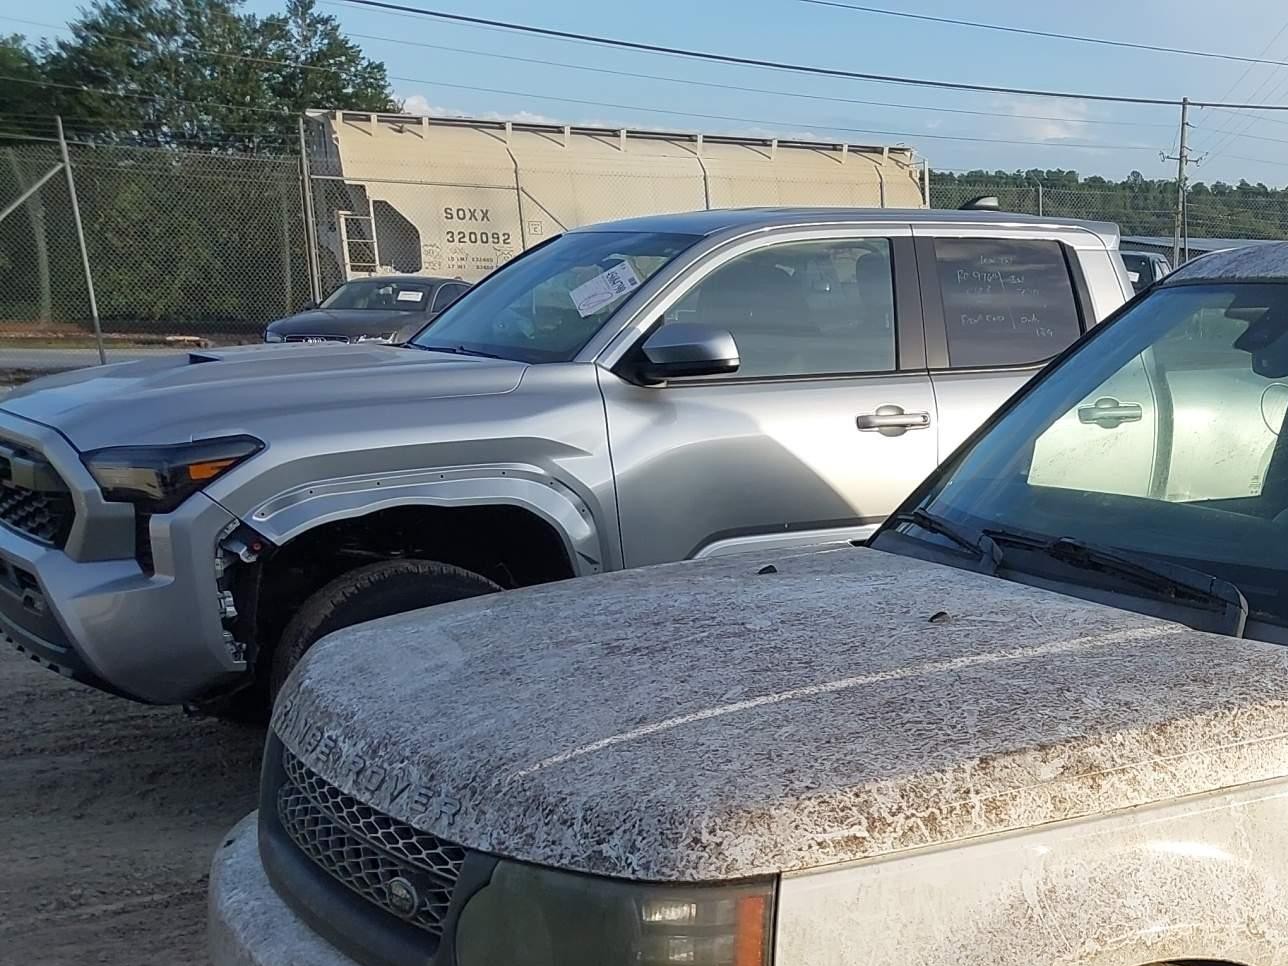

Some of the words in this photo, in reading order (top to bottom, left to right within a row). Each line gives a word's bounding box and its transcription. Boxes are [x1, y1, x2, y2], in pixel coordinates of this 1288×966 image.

[444, 207, 490, 222] SOXX
[446, 230, 511, 245] 320092
[348, 753, 463, 826] ROVER
